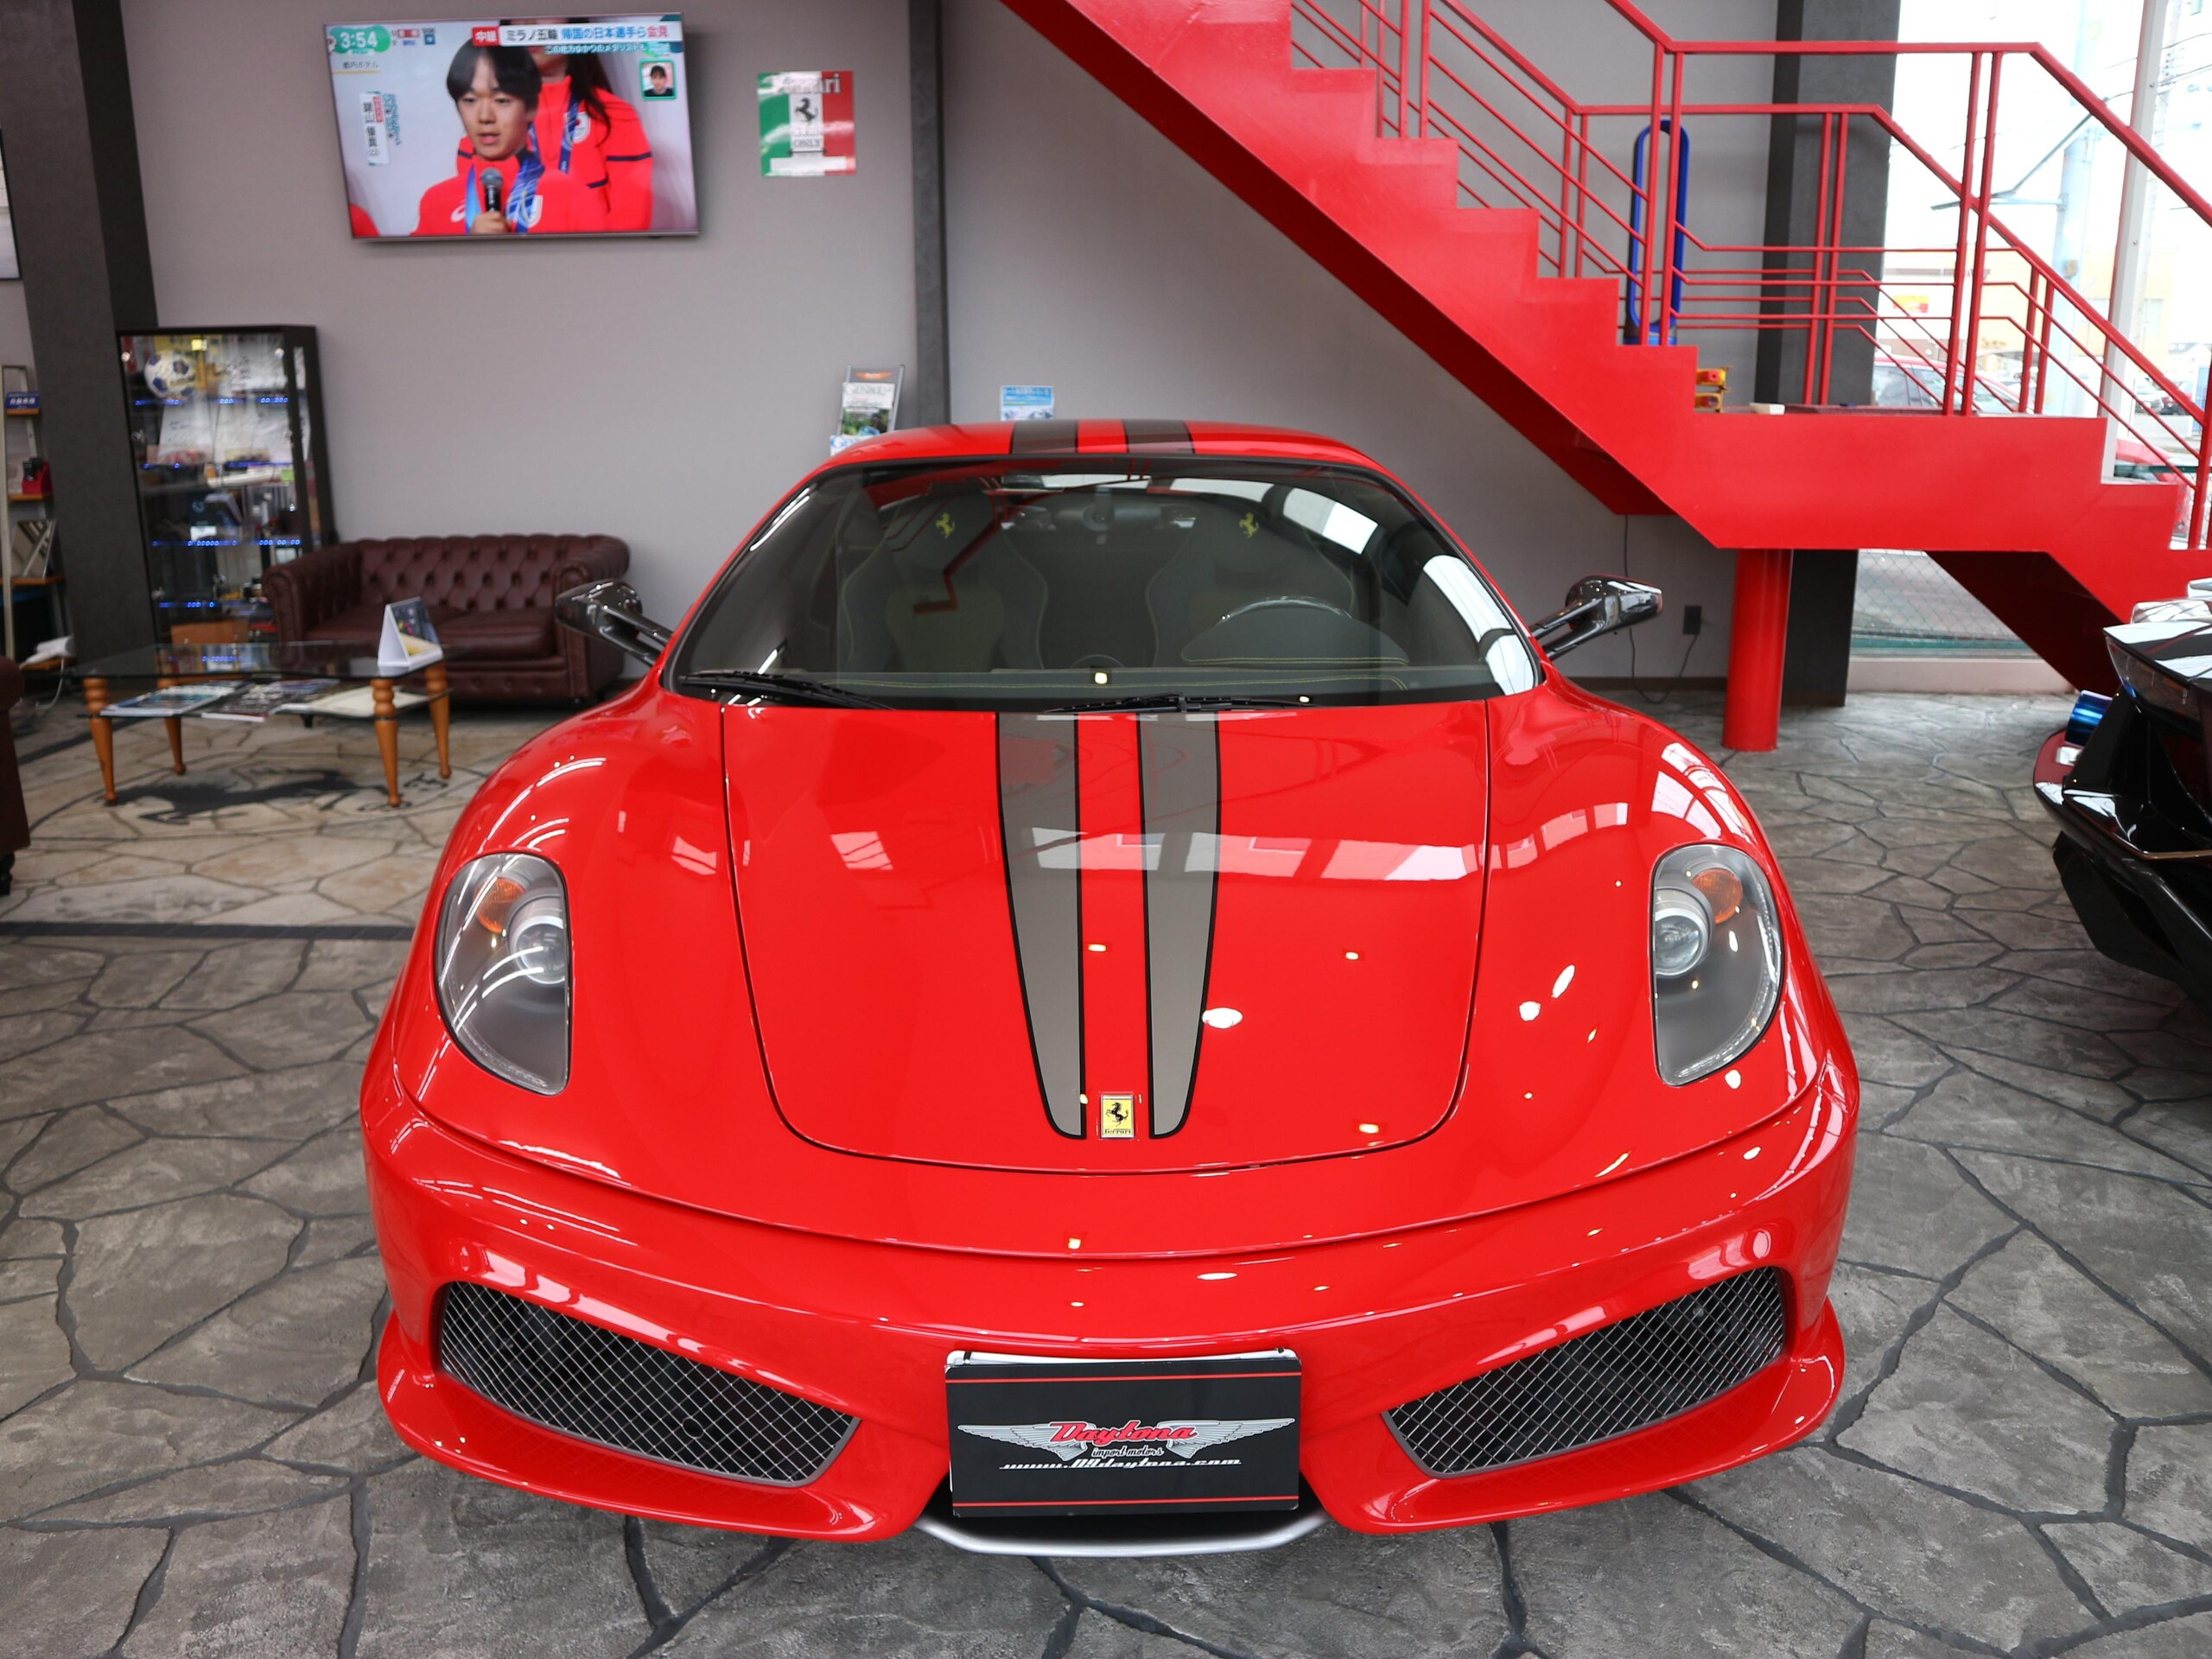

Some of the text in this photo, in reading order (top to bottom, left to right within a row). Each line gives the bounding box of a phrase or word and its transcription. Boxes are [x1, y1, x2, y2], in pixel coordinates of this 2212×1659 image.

[340, 31, 378, 48] 3:54
[506, 28, 558, 41] ミラノ五輪
[1049, 1420, 1199, 1446] Daytona
[1091, 1446, 1165, 1459] import motors
